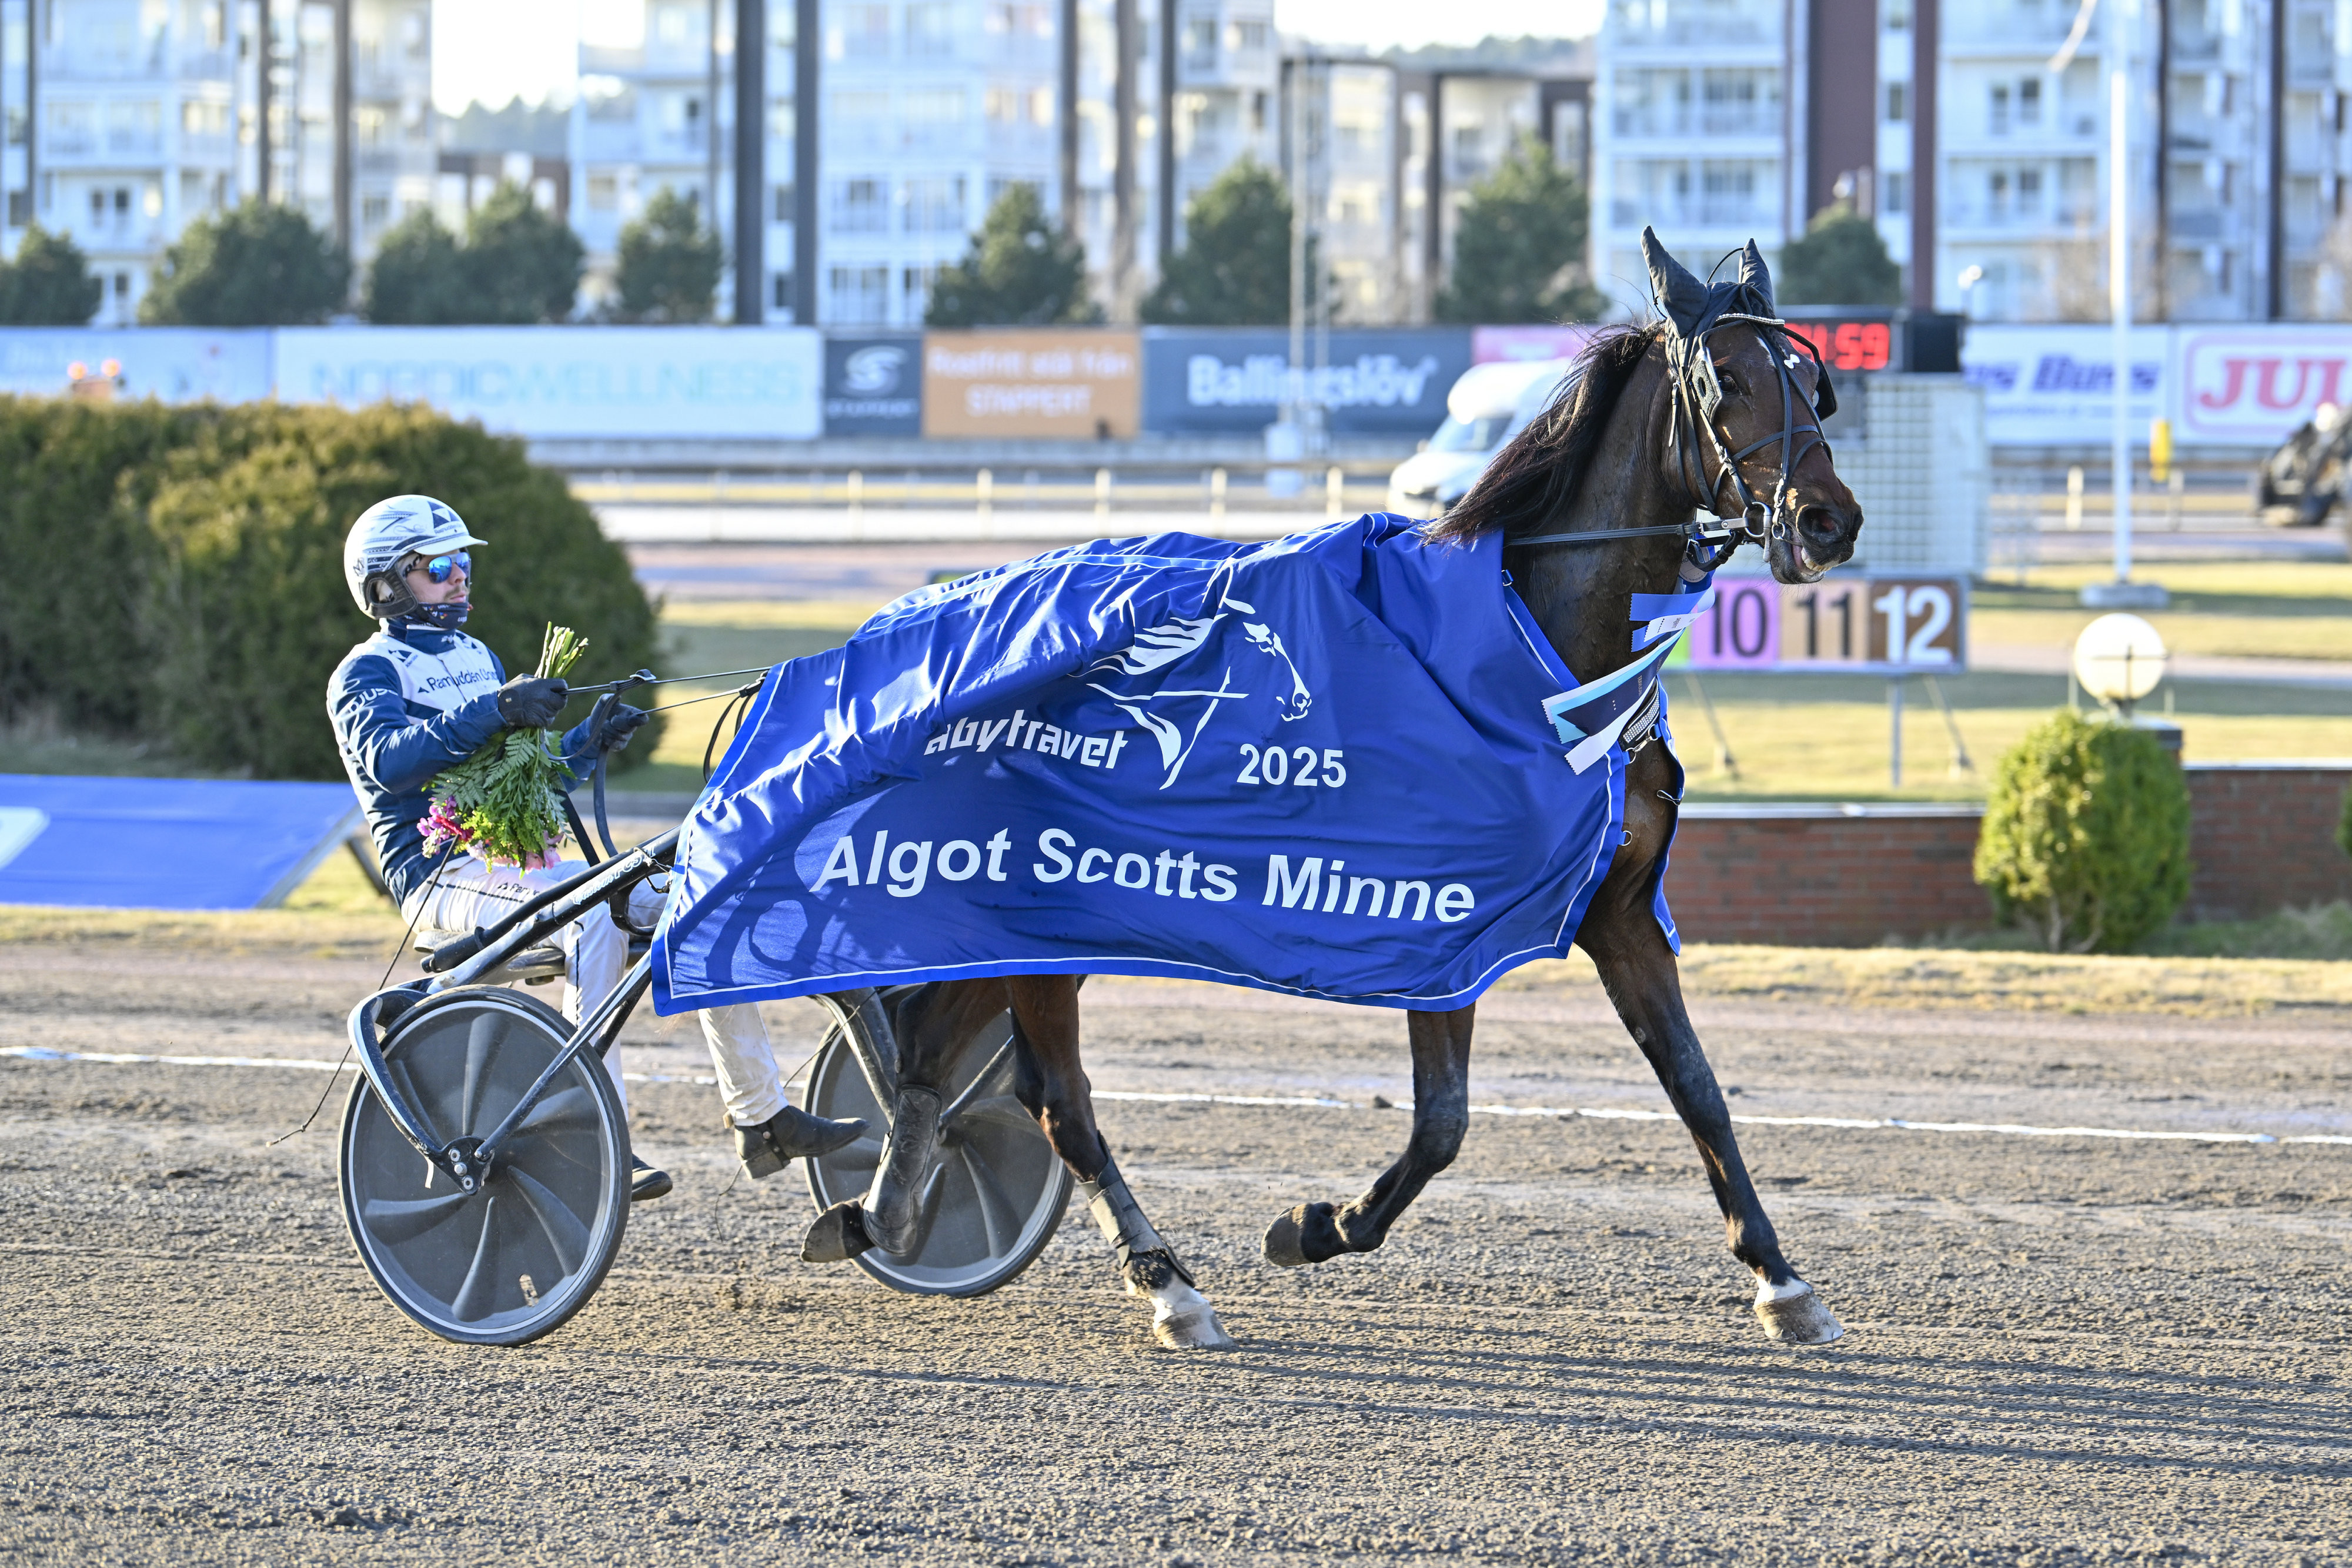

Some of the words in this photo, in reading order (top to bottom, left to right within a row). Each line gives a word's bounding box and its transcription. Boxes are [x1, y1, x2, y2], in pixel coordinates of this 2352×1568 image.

[1712, 590, 1768, 658] 10
[1795, 591, 1852, 658] 11
[1873, 586, 1951, 664] 12
[426, 670, 482, 691] Ramudden
[1236, 743, 1347, 788] 2025
[809, 827, 1011, 898] Algot
[1033, 828, 1238, 902] Scotts
[1262, 854, 1476, 922] Minne
